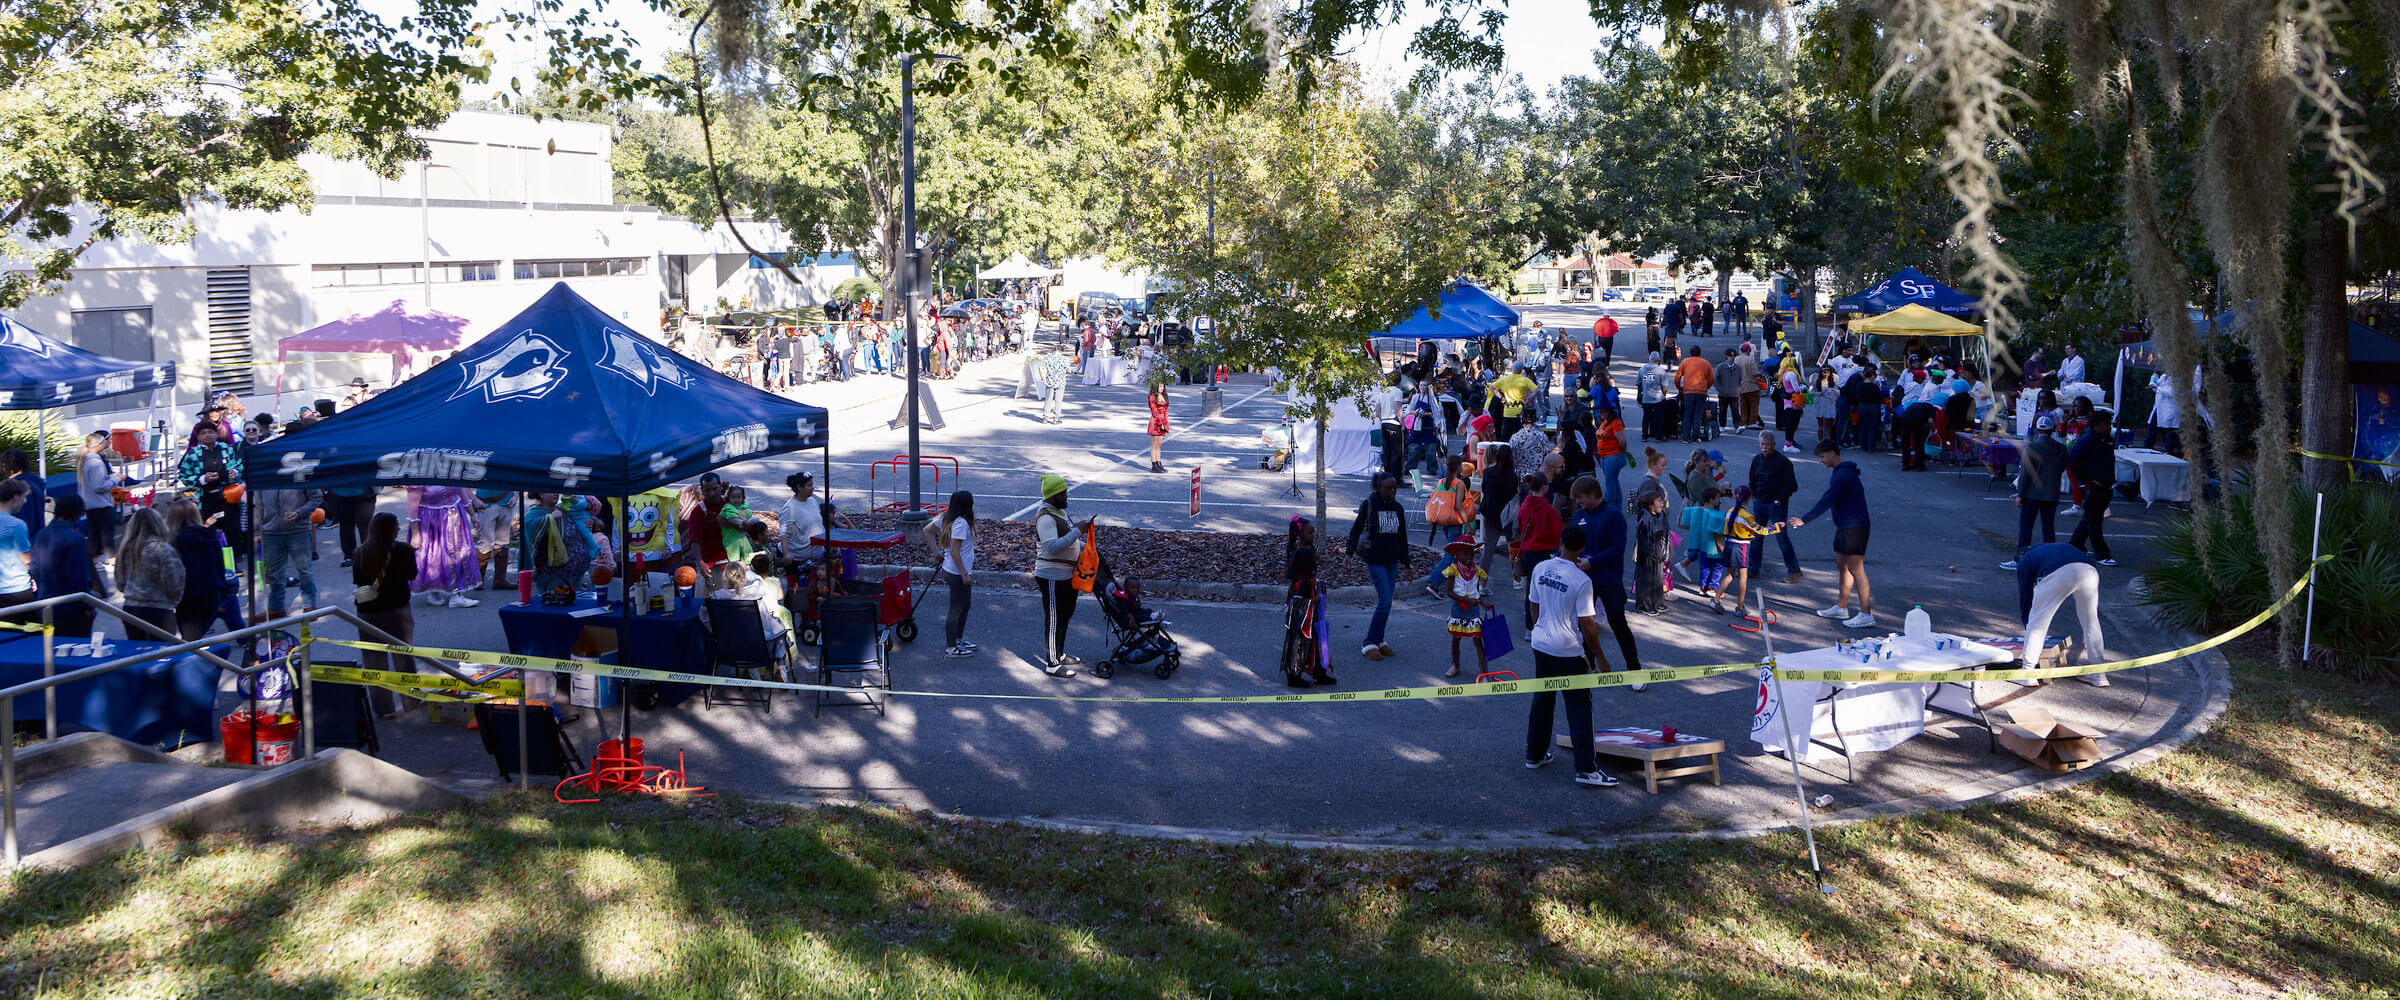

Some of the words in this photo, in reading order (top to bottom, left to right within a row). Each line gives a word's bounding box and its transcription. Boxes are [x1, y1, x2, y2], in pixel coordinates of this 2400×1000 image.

[1900, 280, 1935, 298] SF
[95, 376, 135, 396] SAINTS
[450, 448, 495, 458] COLLEGE
[710, 429, 770, 464] SAINTS
[277, 452, 320, 482] SF
[376, 452, 489, 481] SAINTS
[550, 456, 592, 488] SF
[1538, 576, 1568, 592] SAINTS
[440, 650, 470, 660] CAUTION
[499, 655, 528, 667] CAUTION
[554, 660, 584, 672] CAUTION
[612, 667, 641, 677] CAUTION
[668, 672, 696, 681] CAUTION
[362, 670, 381, 680] CAUTION
[400, 674, 420, 684] CAUTION
[440, 678, 461, 687] CAUTION
